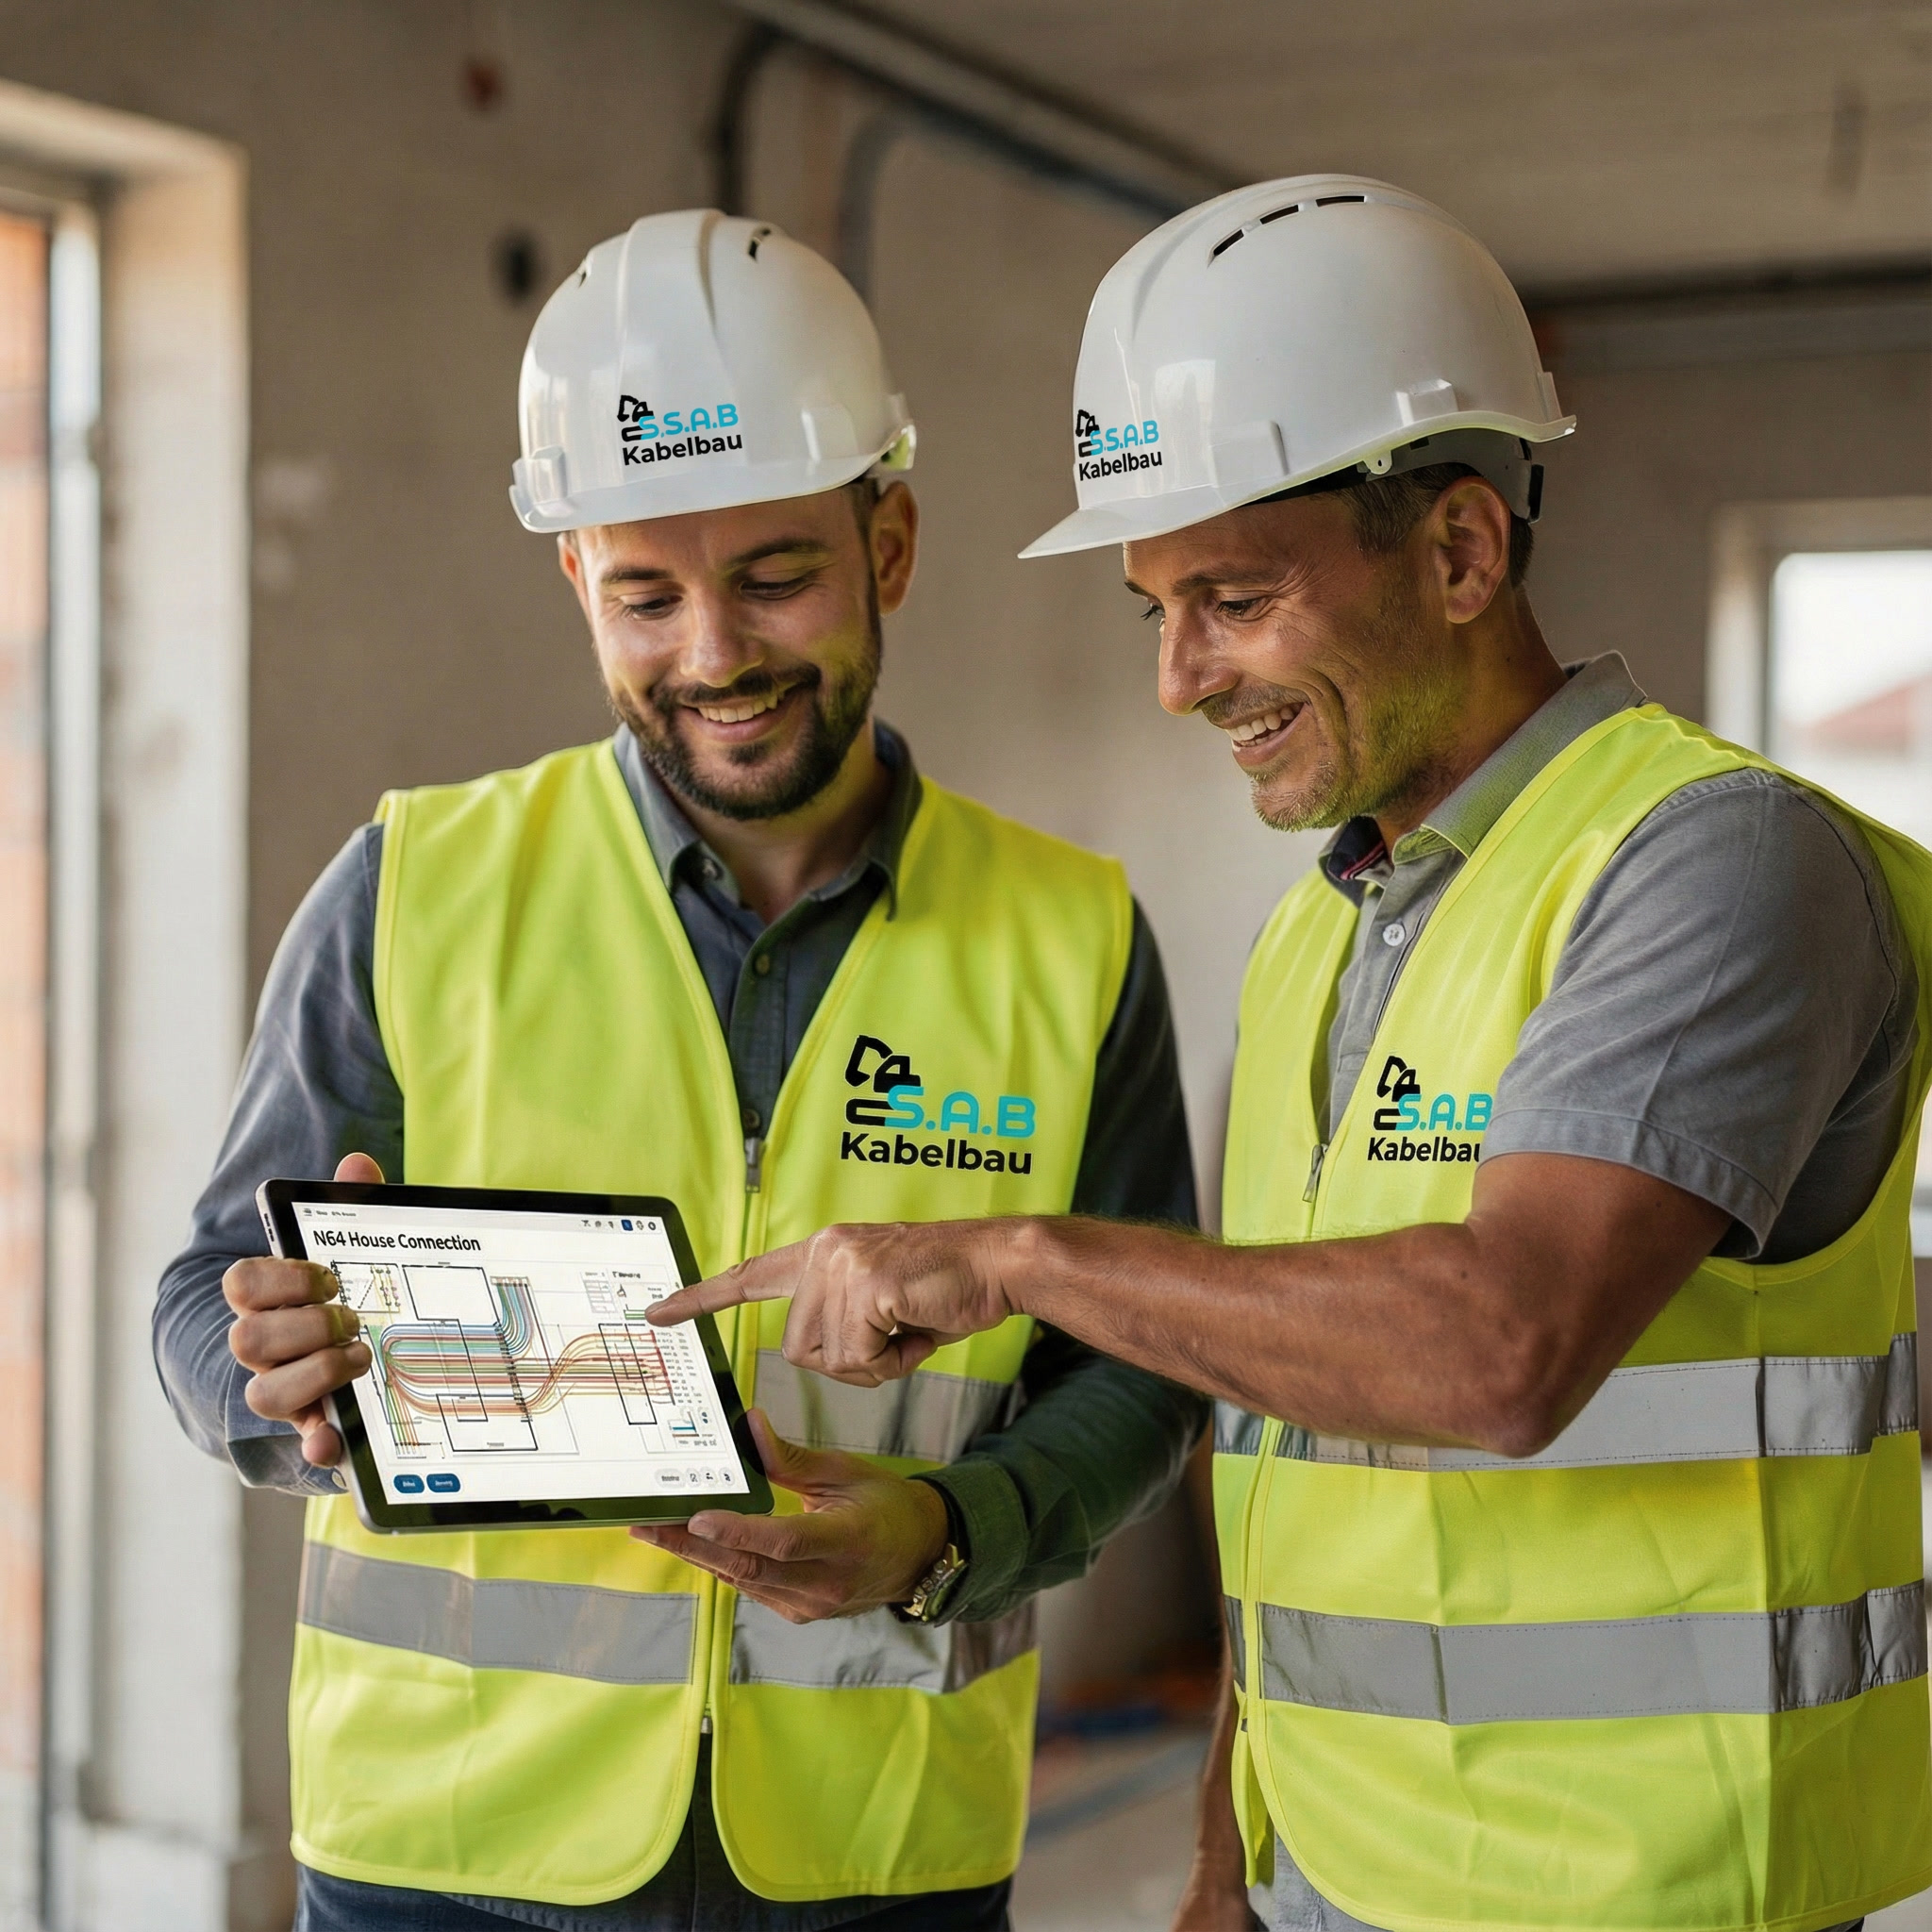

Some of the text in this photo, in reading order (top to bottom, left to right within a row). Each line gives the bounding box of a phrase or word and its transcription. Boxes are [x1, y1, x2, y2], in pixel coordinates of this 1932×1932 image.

[638, 404, 739, 441] S.S.A.B
[623, 434, 742, 466] Kabelbau
[1078, 451, 1163, 481] Kabelbau
[884, 1084, 1037, 1139] S.A.B
[1396, 1093, 1493, 1131] S.A.B
[841, 1131, 1032, 1175] Kabelbau
[313, 1230, 482, 1252] N64 House Connection
